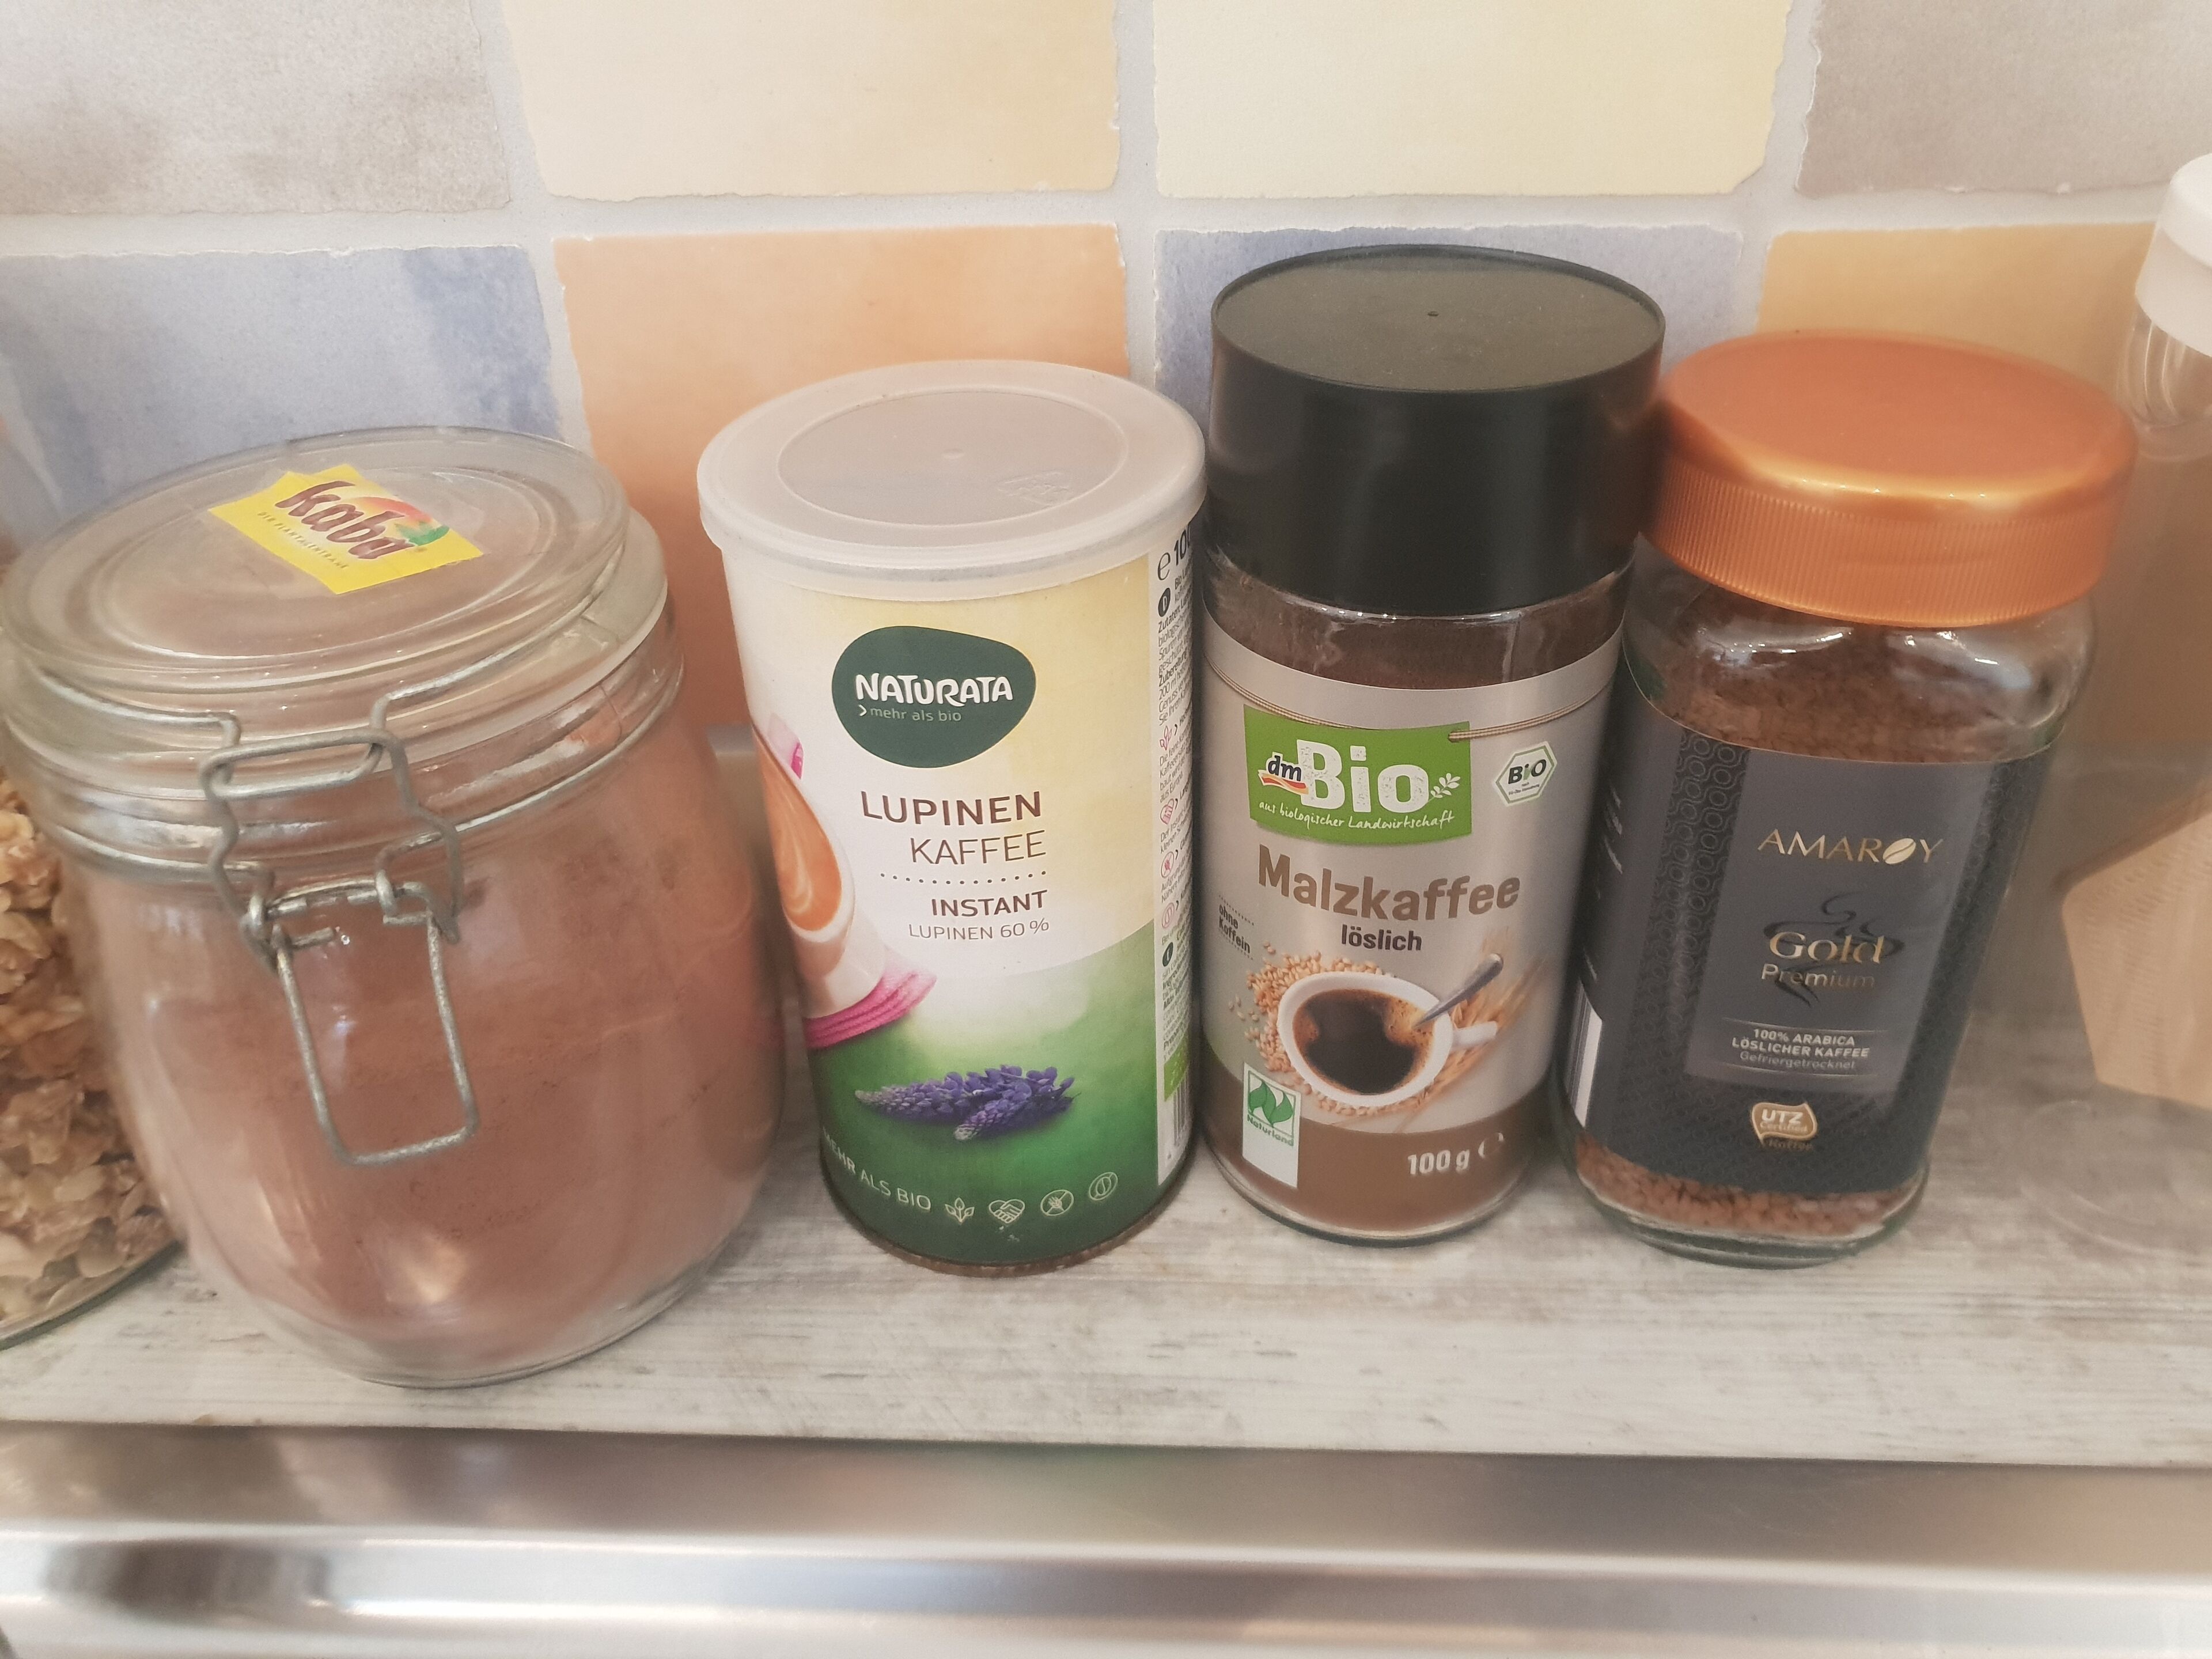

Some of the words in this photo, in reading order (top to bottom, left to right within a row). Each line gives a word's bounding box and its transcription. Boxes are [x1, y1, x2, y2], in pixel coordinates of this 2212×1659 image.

[855, 672, 1014, 707] NATURATA
[870, 706, 907, 719] mehr
[912, 709, 934, 722] als
[938, 710, 962, 722] bio
[1267, 755, 1302, 782] dm
[1297, 738, 1430, 813] Bio
[861, 790, 1041, 826] LUPINEN
[1259, 800, 1276, 813] aus
[1279, 802, 1346, 830] biologischer
[1348, 810, 1455, 830] Landwirtschaft
[910, 830, 1047, 865] KAFFEE
[1757, 828, 1944, 865] AMAROY
[1257, 843, 1521, 921] Malzkaffee
[931, 889, 1048, 917] INSTANT
[1218, 903, 1239, 929] ohne
[908, 923, 993, 940] LUPINEN
[1000, 922, 1025, 938] 60
[1340, 923, 1422, 951] löslich
[1768, 931, 1886, 964] Gold
[1761, 963, 1876, 988] Premium
[1732, 1036, 1811, 1056] LÖSLICHER
[1815, 1047, 1870, 1058] KAFFEE
[1753, 1028, 1789, 1043] 100%
[1792, 1033, 1855, 1047] ARABICA
[1246, 1113, 1295, 1147] Naturland
[1762, 1108, 1804, 1124] UTZ
[1407, 1150, 1450, 1176] 100
[1456, 1148, 1471, 1172] g
[861, 1169, 892, 1197] ALS
[897, 1187, 932, 1211] BIO
